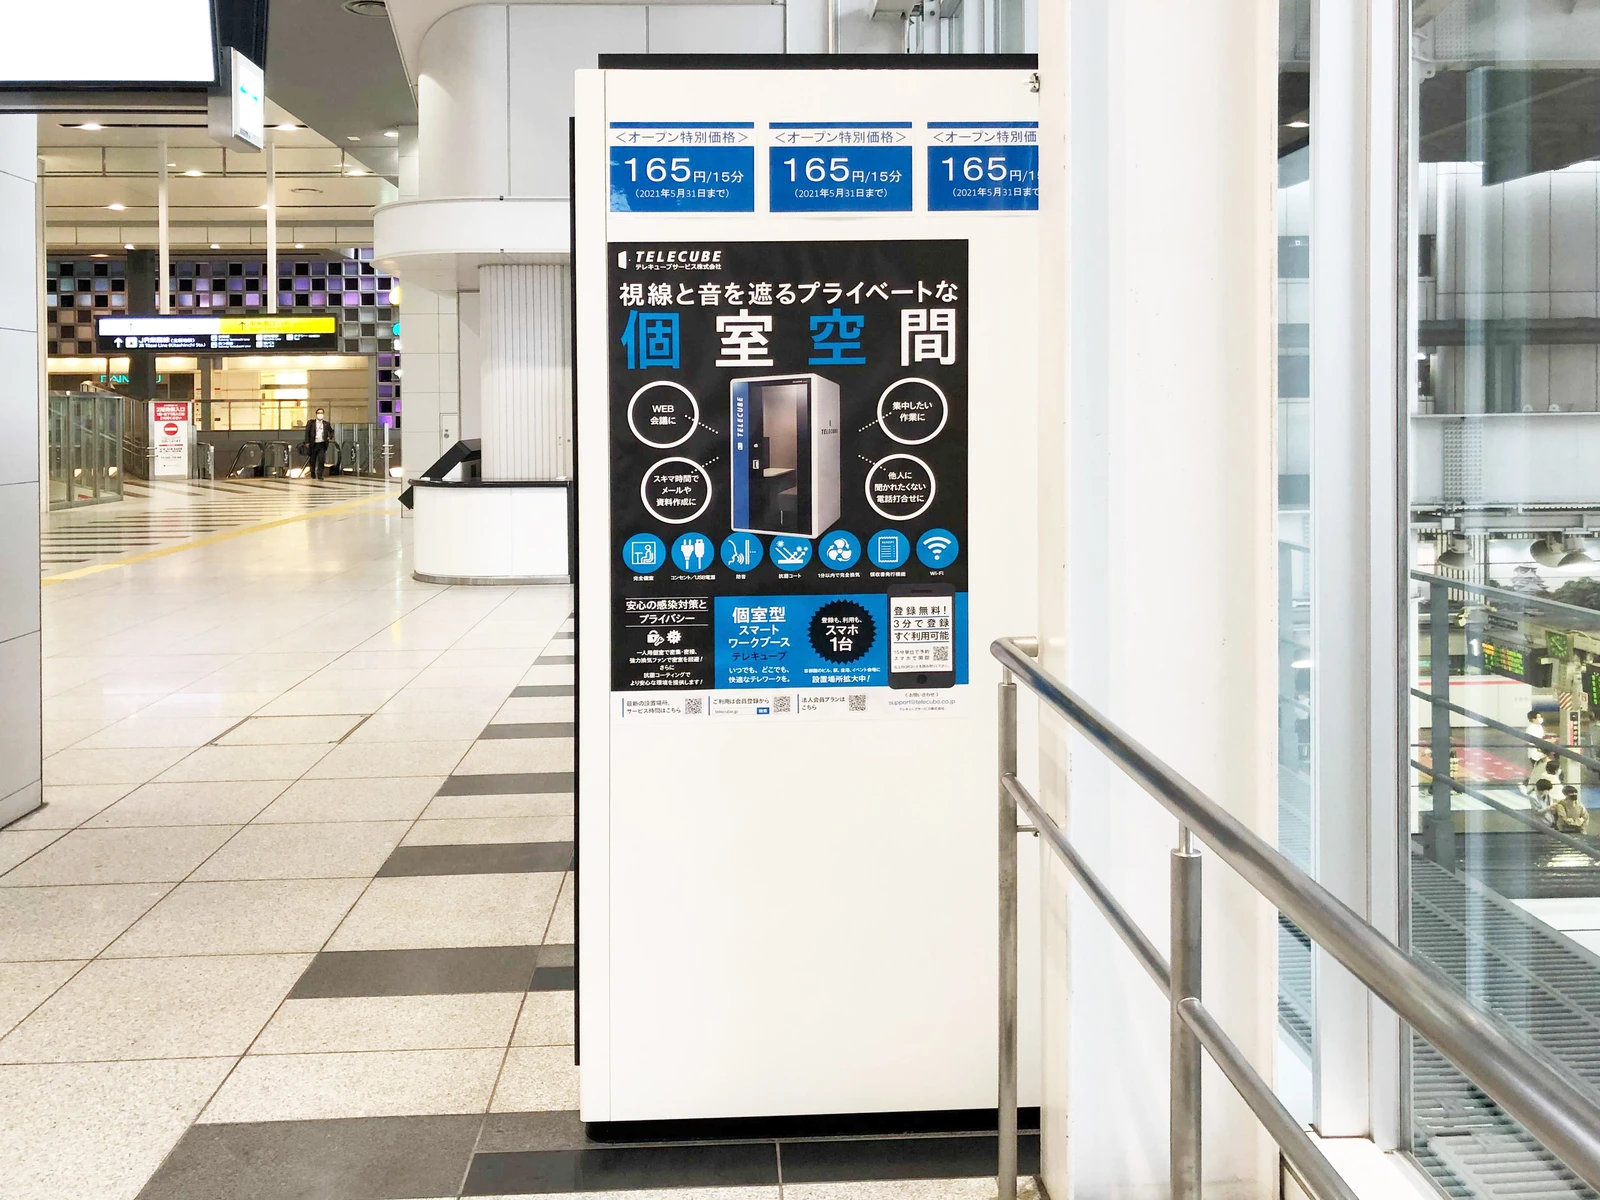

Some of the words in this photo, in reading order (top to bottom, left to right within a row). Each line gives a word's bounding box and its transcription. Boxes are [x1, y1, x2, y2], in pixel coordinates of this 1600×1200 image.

[942, 157, 1039, 182] 165円/1
[636, 250, 722, 262] TELECUBE
[620, 280, 958, 306] 視線と音を遮るプライベートな
[892, 402, 932, 410] 集中したい
[650, 416, 676, 425] 会議に
[736, 397, 744, 437] TELECUBE
[900, 414, 926, 422] 作業に
[653, 474, 700, 483] スキマ時間で
[888, 472, 912, 480] 他人に
[874, 484, 926, 492] 聞かれたくない
[656, 498, 696, 506] 資料作成に
[876, 495, 924, 504] 電話打合せに
[626, 600, 707, 610] 安心の感染対策と
[639, 614, 695, 624] プライバシー
[732, 606, 786, 623] 個室型
[893, 618, 950, 628] 3分で登録
[738, 624, 780, 636] スマート
[826, 624, 859, 636] スマホ
[894, 631, 950, 641] すぐ利用可能
[728, 637, 790, 648] ワークブース
[830, 637, 853, 652] 1台
[732, 651, 788, 662] テレキューブ
[728, 676, 791, 684] 快適なテレワークを。
